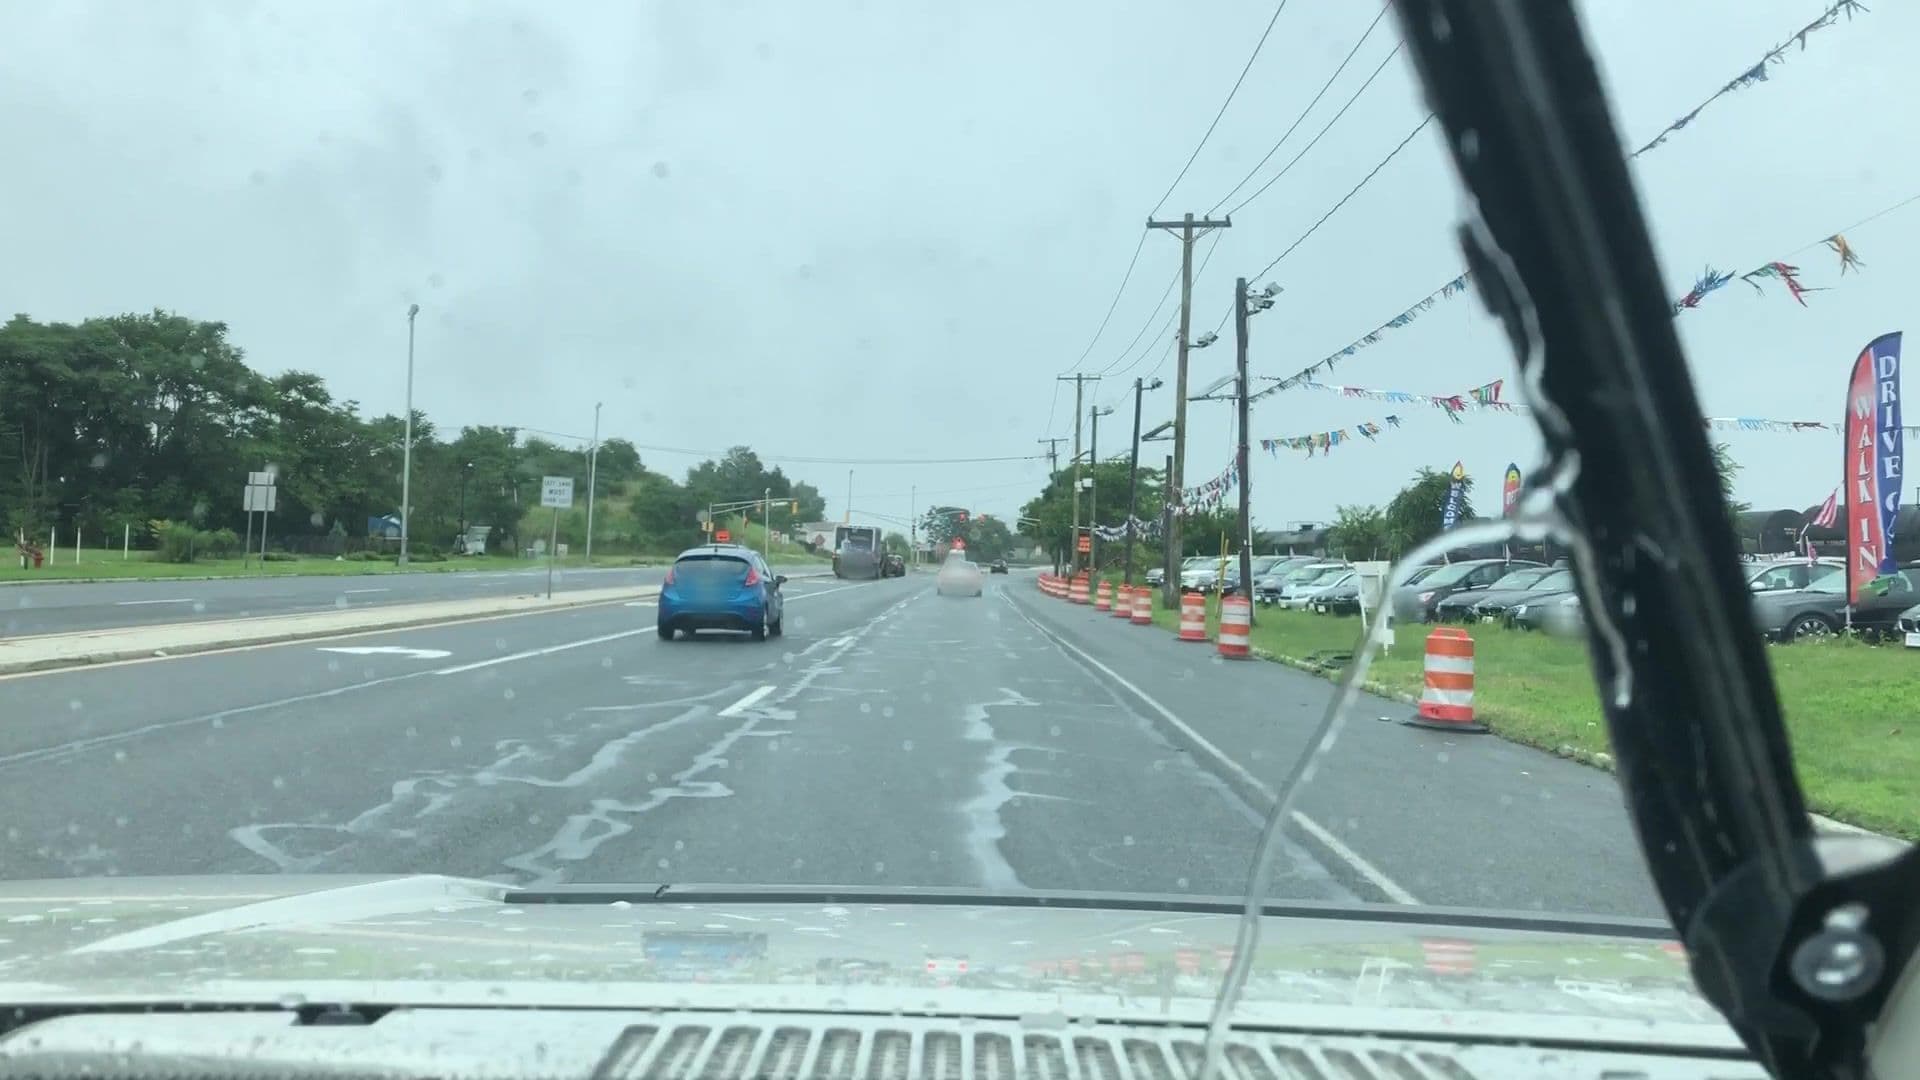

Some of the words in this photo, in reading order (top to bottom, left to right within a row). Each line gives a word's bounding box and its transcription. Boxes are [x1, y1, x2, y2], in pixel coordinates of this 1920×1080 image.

[1856, 394, 1873, 503] WALK
[1879, 355, 1901, 479] DRIVE
[1859, 518, 1878, 570] IN
